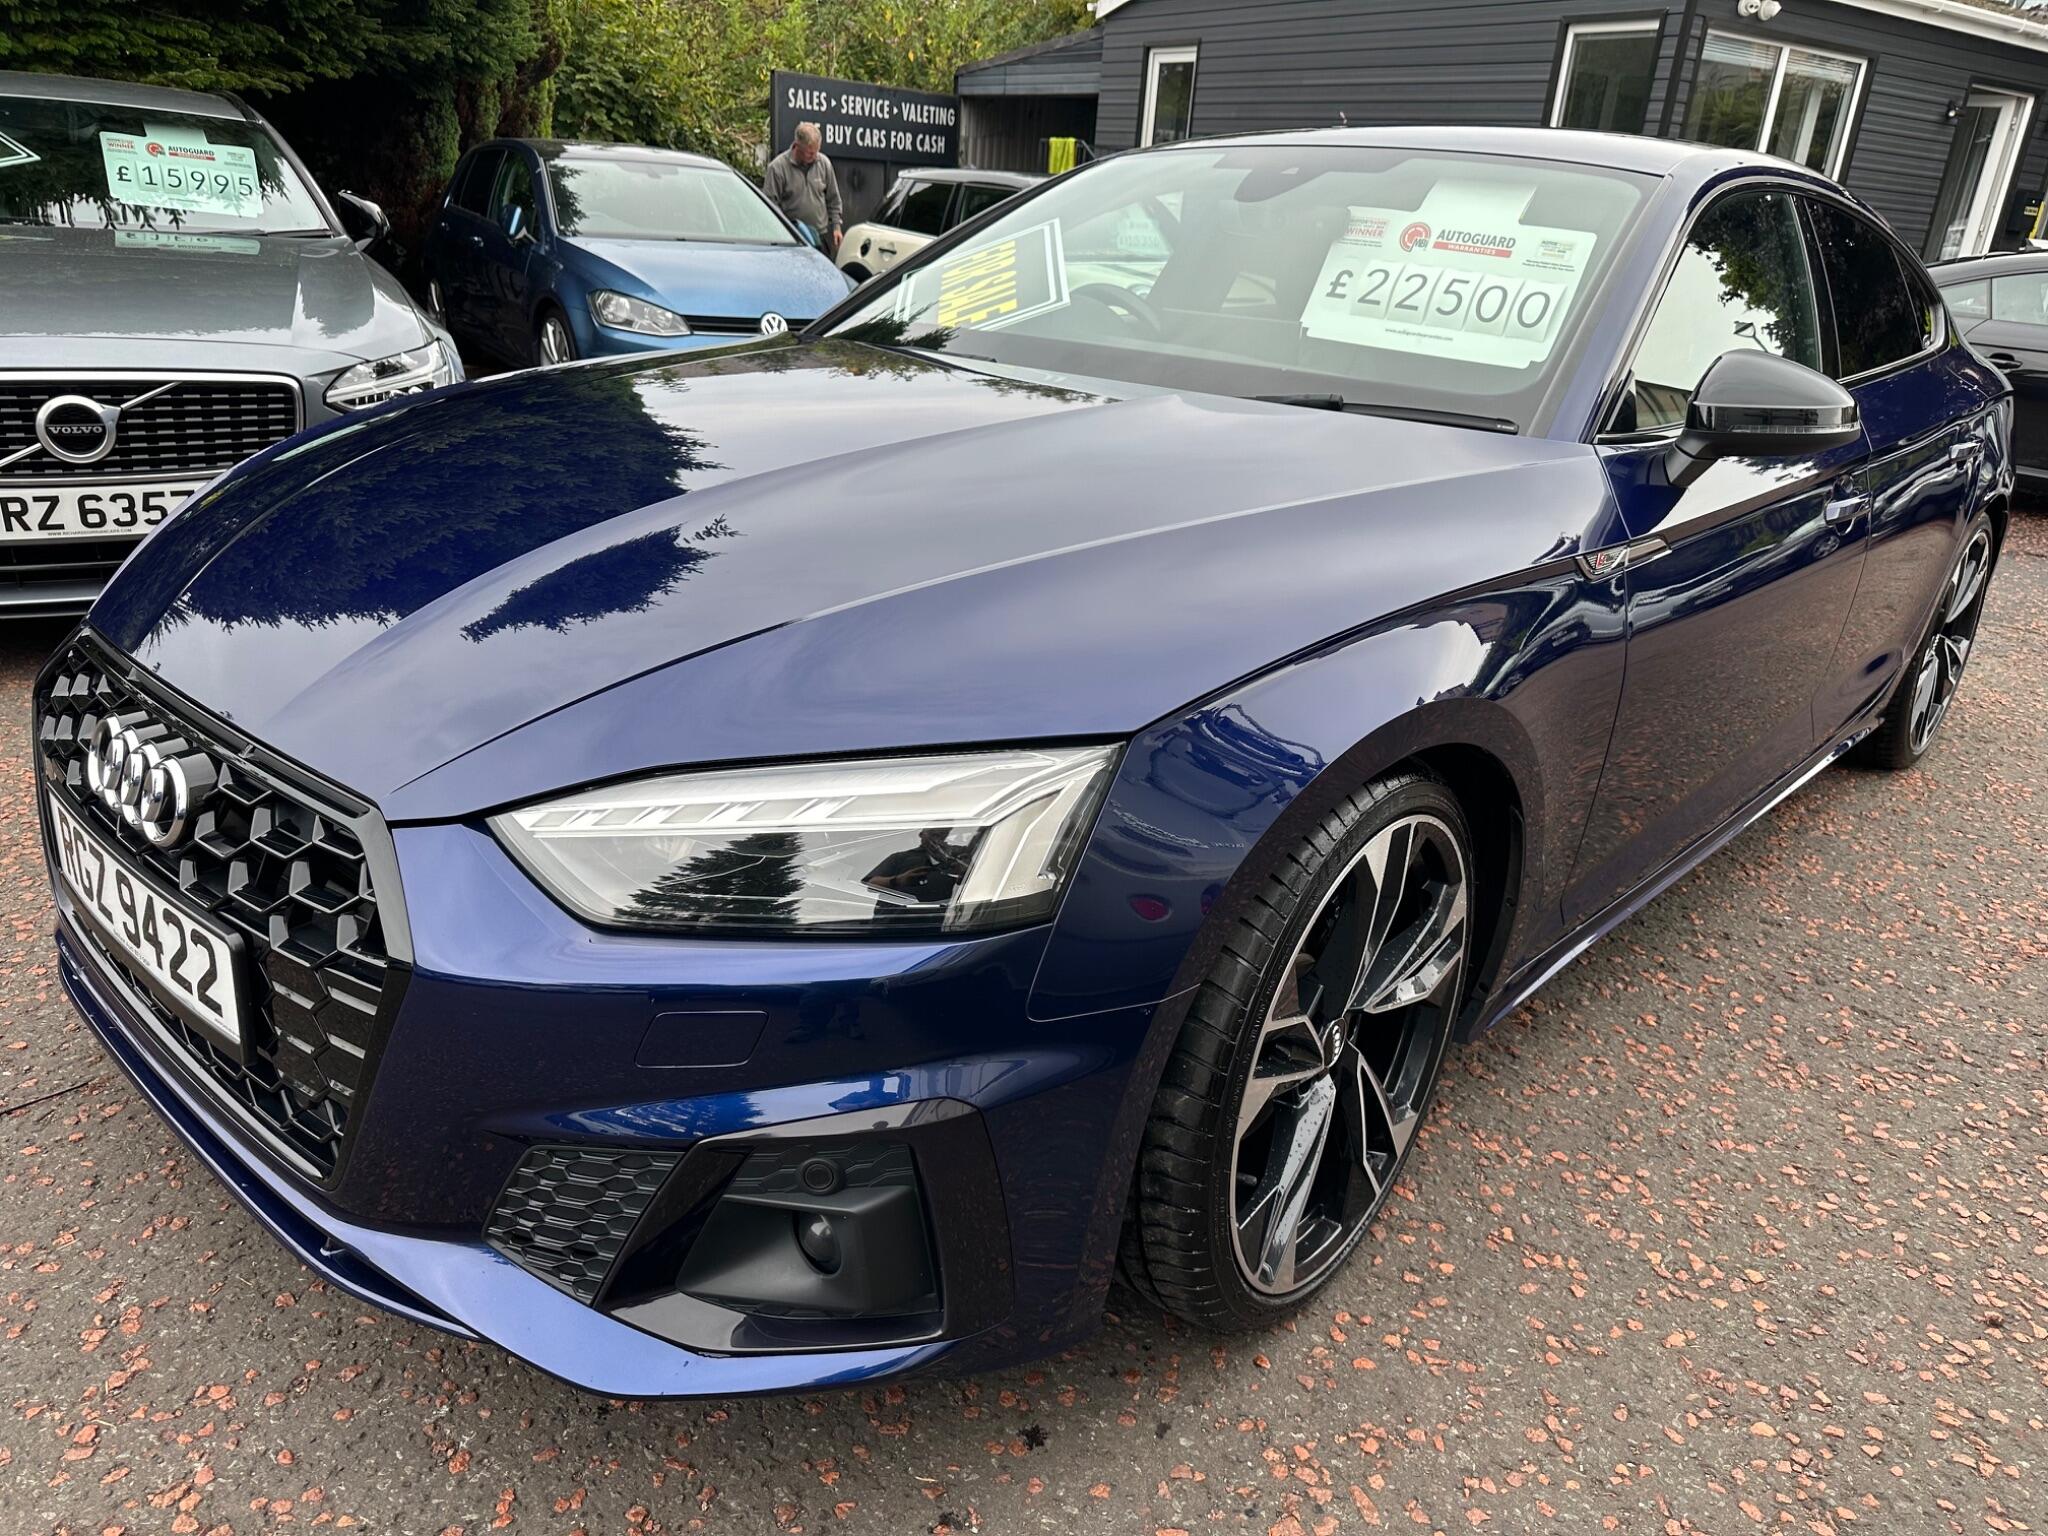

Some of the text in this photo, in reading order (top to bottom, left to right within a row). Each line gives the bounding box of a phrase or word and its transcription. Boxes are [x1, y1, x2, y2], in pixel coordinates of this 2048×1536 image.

[788, 87, 956, 127] SALES SERVICE VALETING
[168, 145, 215, 157] AUTOGUARD
[826, 124, 852, 145] BUY
[856, 126, 887, 149] CARS
[890, 130, 912, 151] FOR
[916, 133, 946, 155] CASH
[116, 165, 253, 197] £15995
[1345, 226, 1385, 238] WINNER
[1436, 229, 1517, 249] AUTOGUARD
[1447, 243, 1497, 256] WARRANTIES
[1325, 267, 1552, 330] £22500
[48, 425, 103, 435] VOLVO
[56, 805, 224, 1019] RGZ 9422
